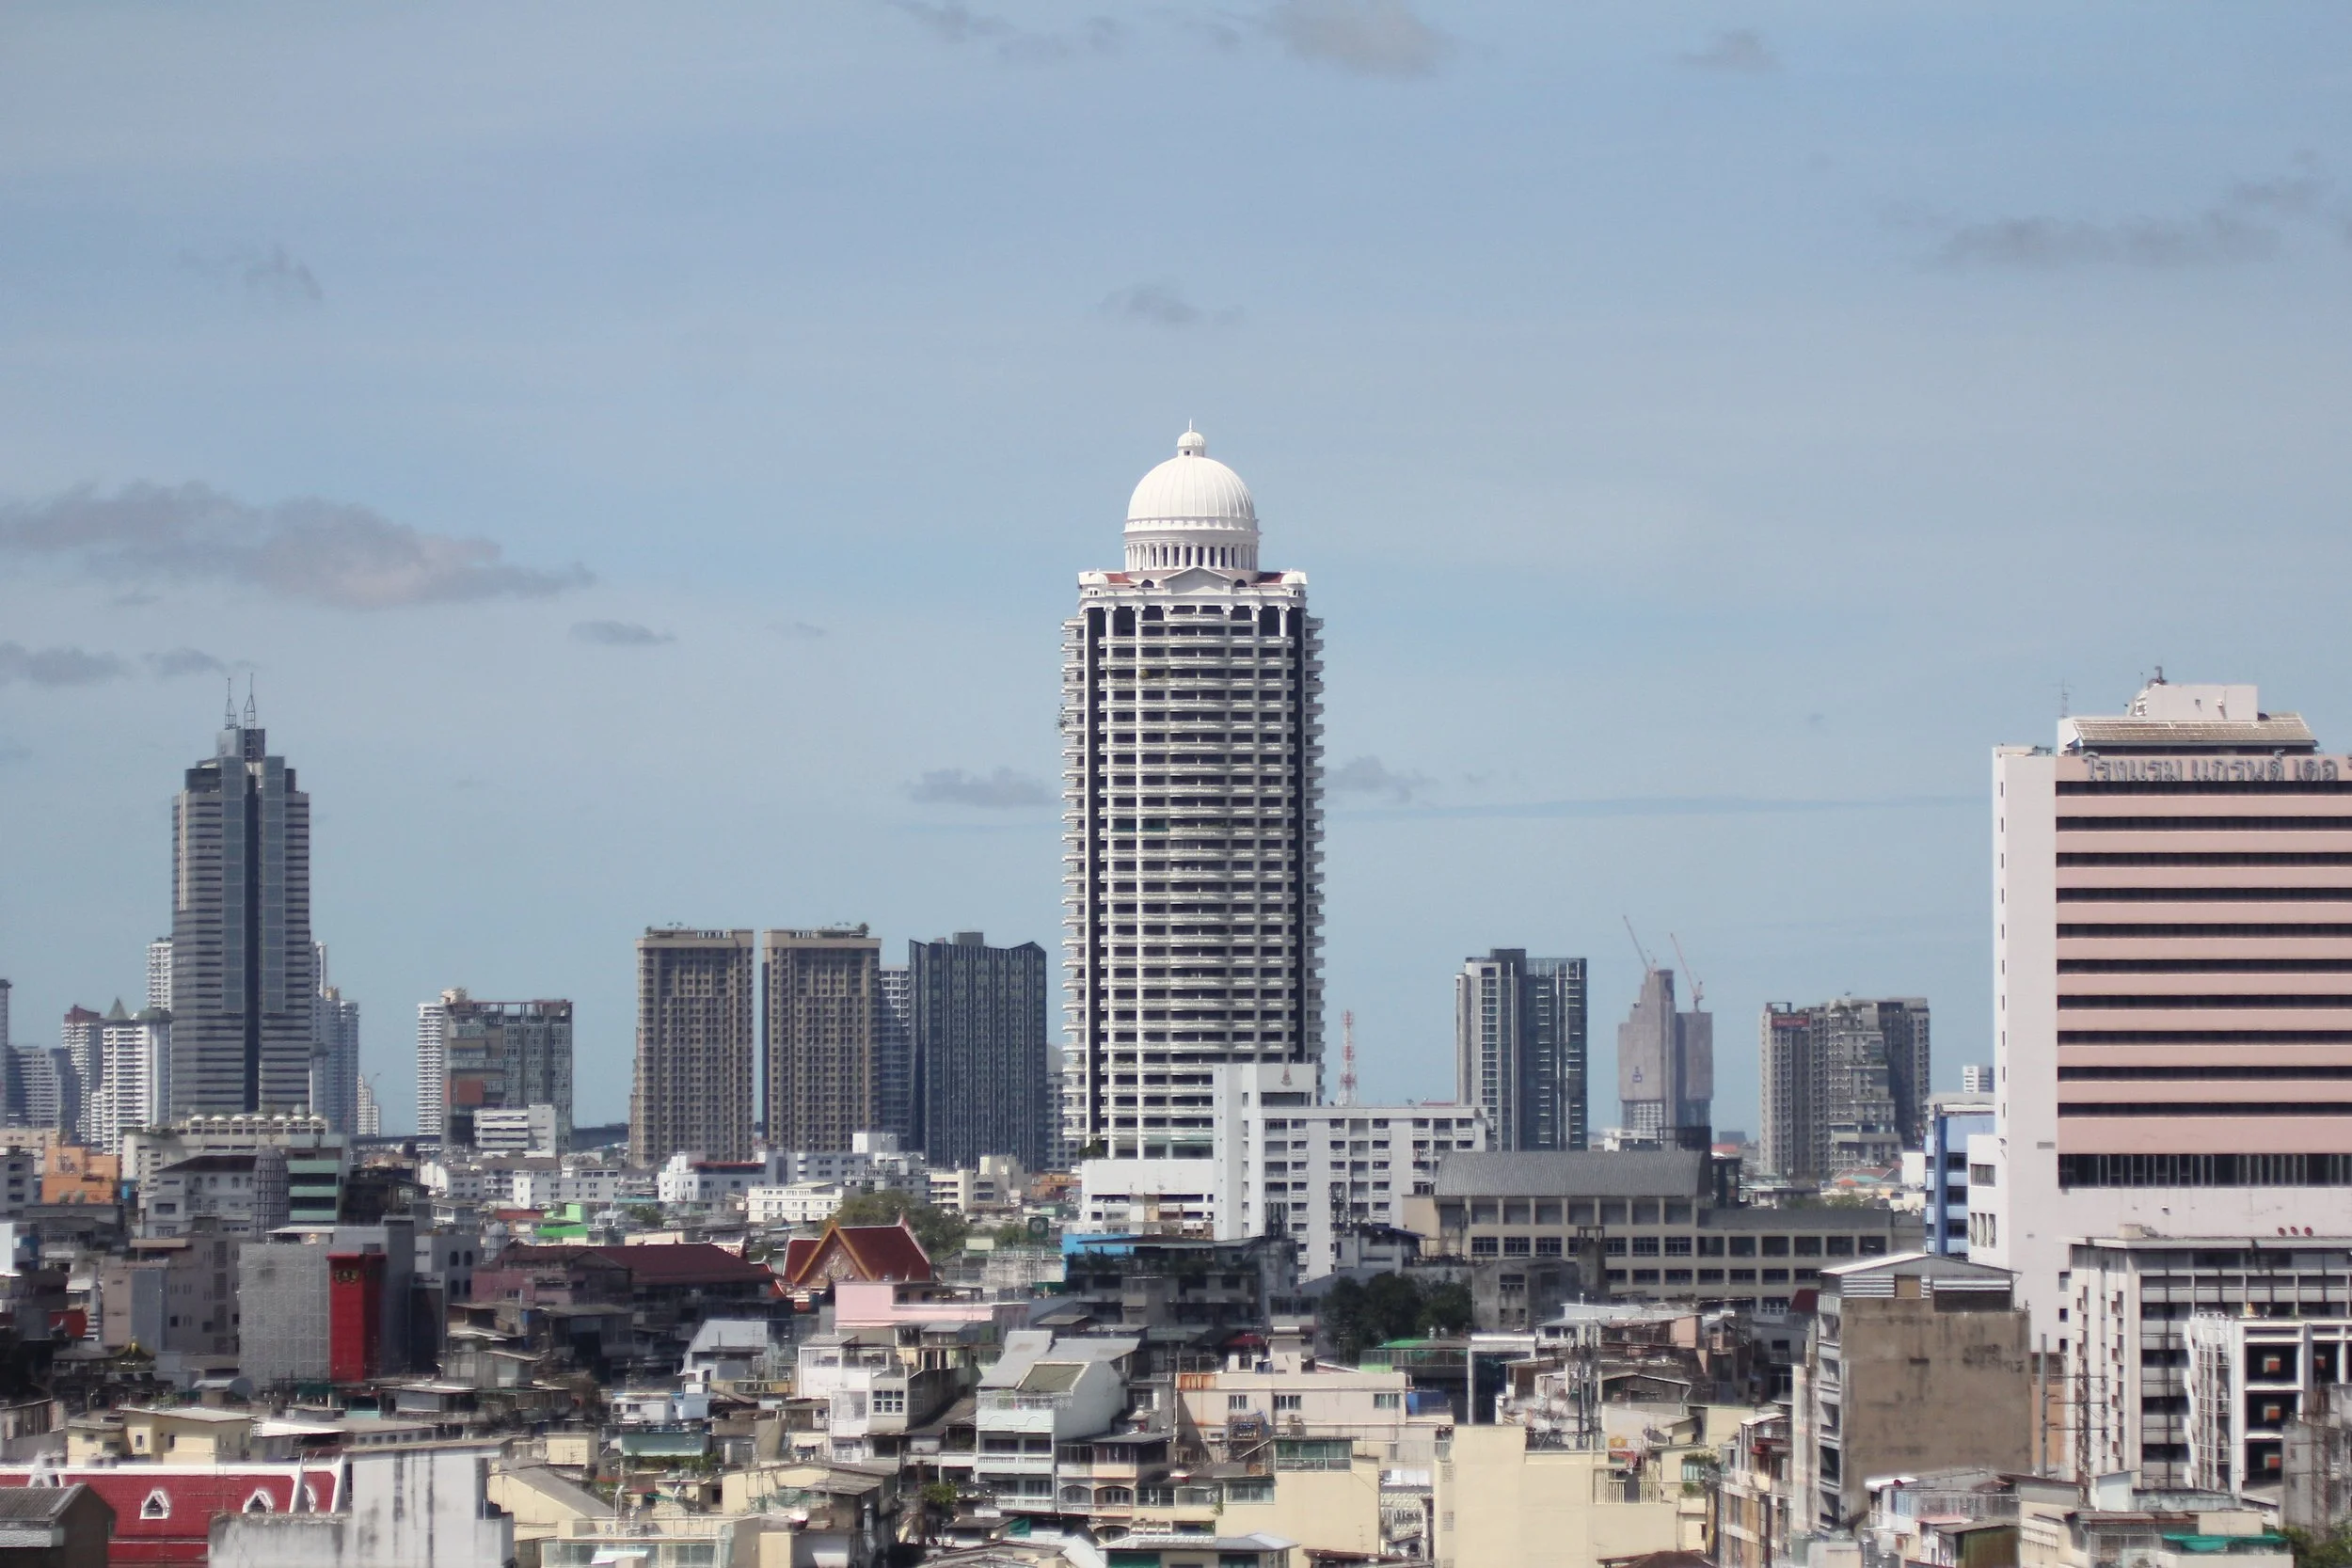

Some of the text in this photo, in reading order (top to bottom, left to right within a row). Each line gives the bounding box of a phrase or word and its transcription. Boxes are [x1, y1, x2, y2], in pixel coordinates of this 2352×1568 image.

[2081, 751, 2183, 781] โรงแรม
[2191, 749, 2285, 781] แกรนด์
